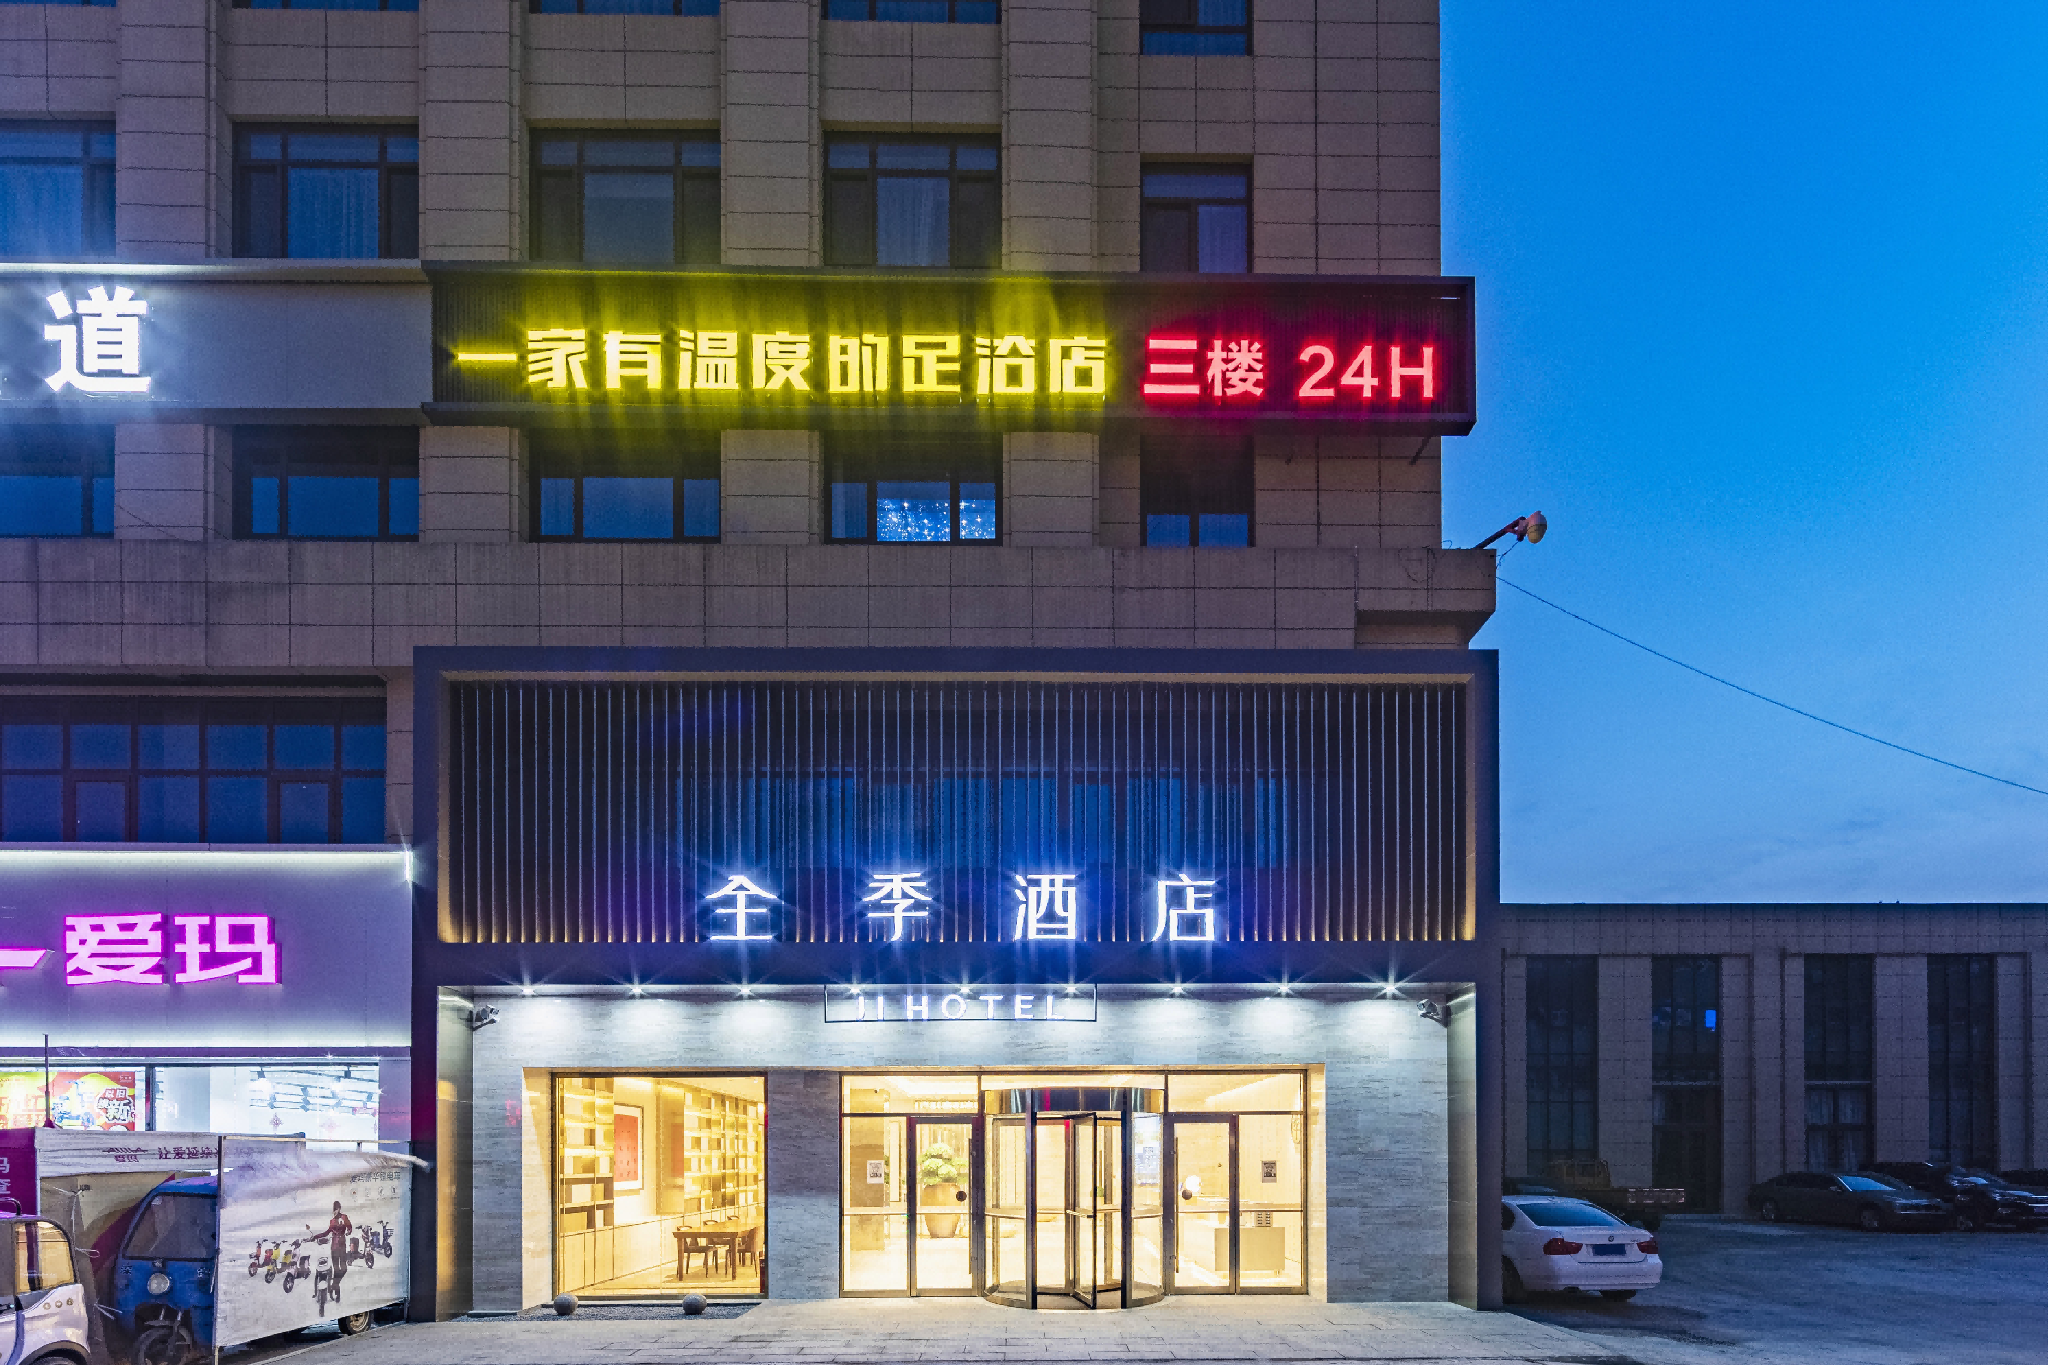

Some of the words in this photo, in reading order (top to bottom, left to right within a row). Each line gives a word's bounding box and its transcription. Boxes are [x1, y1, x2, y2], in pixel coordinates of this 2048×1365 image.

[44, 285, 151, 393] 道
[457, 328, 1106, 395] 一家有温度的足浴店
[1144, 339, 1264, 397] 三楼
[1298, 345, 1434, 398] 24H
[705, 872, 1217, 942] 全季酒店
[64, 912, 277, 985] 爱玛
[857, 994, 885, 1021] JI
[905, 993, 1065, 1020] HOTEL
